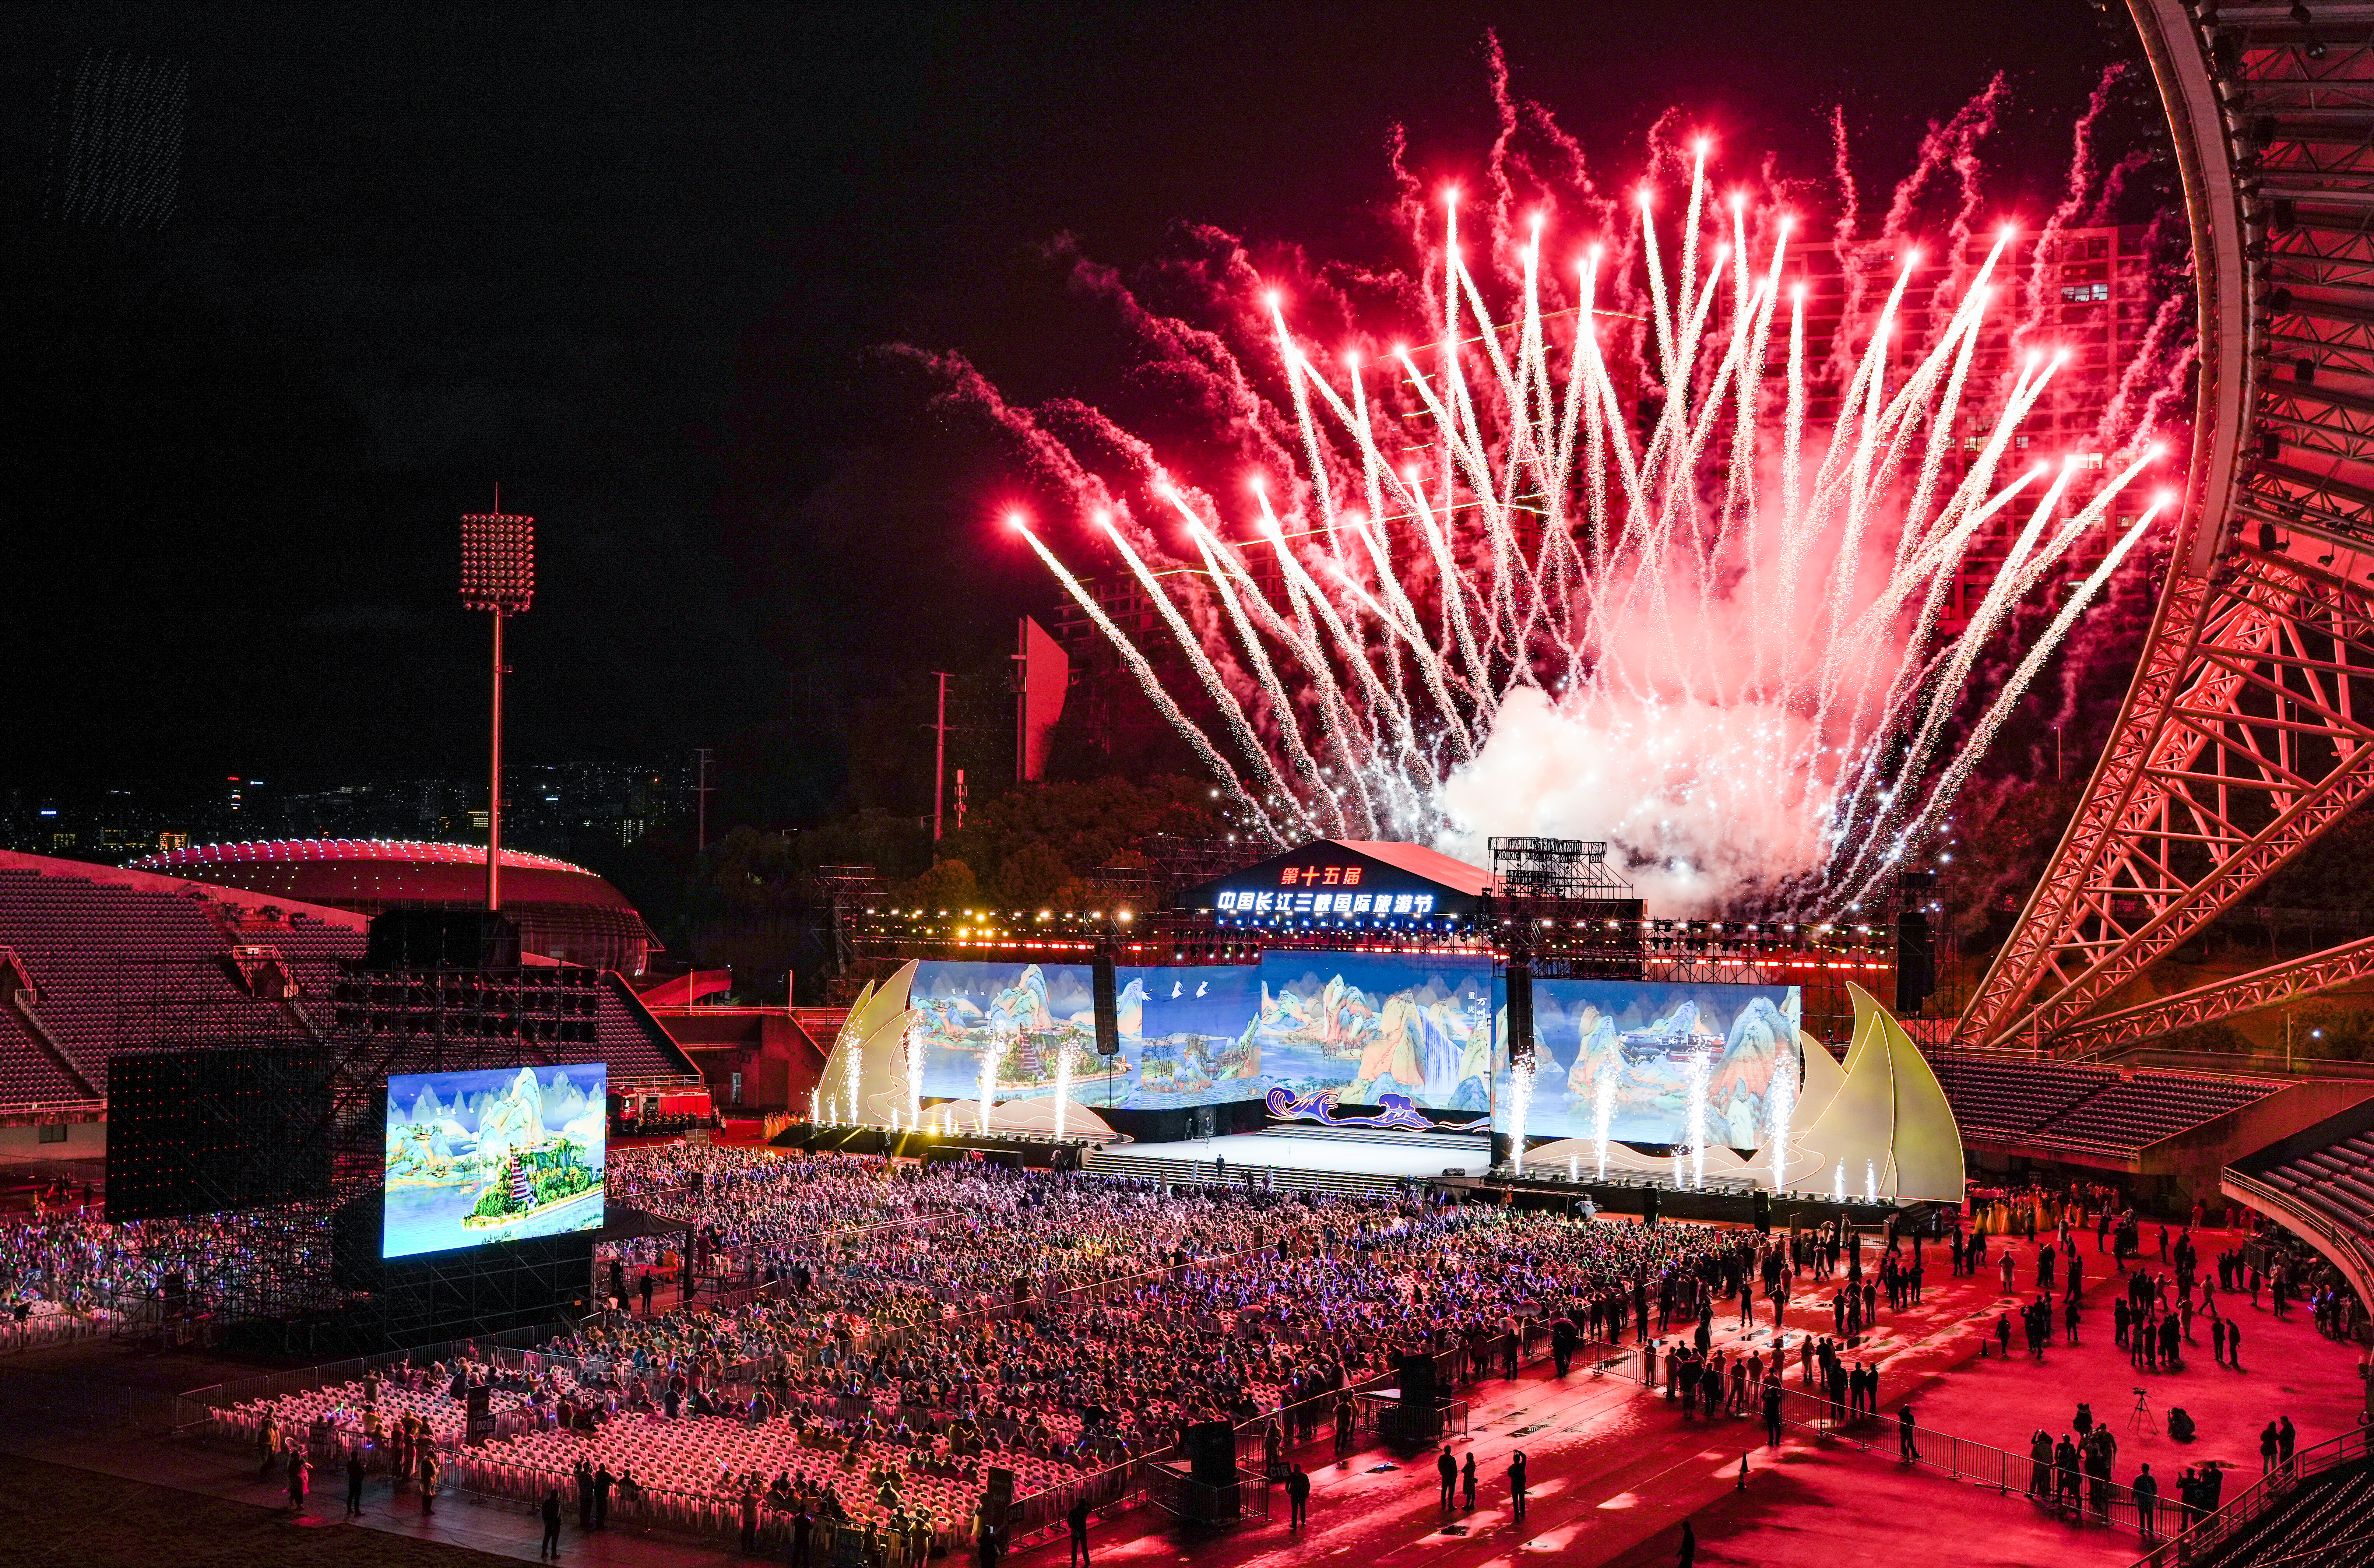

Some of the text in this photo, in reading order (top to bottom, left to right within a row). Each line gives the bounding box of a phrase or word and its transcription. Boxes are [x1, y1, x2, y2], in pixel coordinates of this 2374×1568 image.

[1281, 865, 1362, 886] 第十五届
[1217, 892, 1433, 913] 中国长江三峡国际旅游节
[1477, 997, 1487, 1030] 万州区
[727, 1367, 739, 1379] C2区
[477, 1418, 494, 1431] D2区
[1270, 1465, 1290, 1477] C1区
